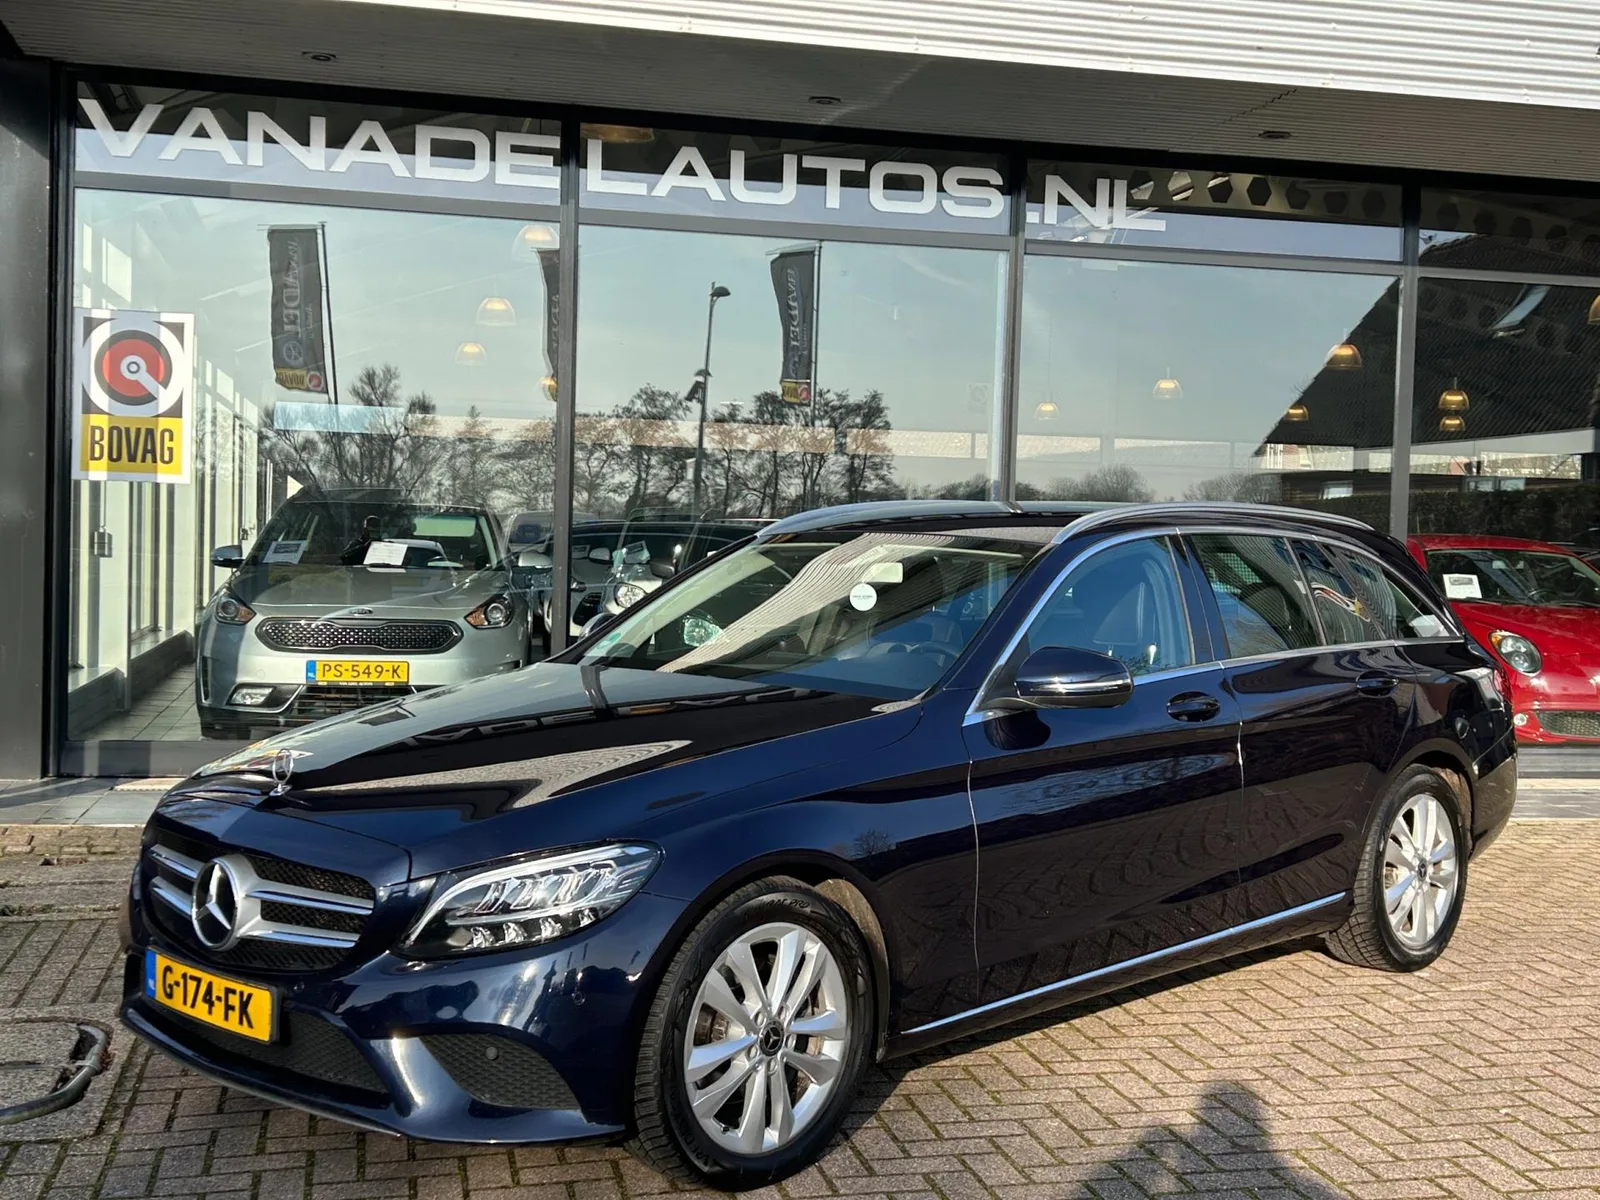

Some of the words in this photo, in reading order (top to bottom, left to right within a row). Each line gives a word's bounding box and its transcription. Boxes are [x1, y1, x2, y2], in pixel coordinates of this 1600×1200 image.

[89, 425, 174, 465] BOVAG
[322, 663, 402, 679] PS-549-K
[162, 965, 254, 1029] G-174-FK
